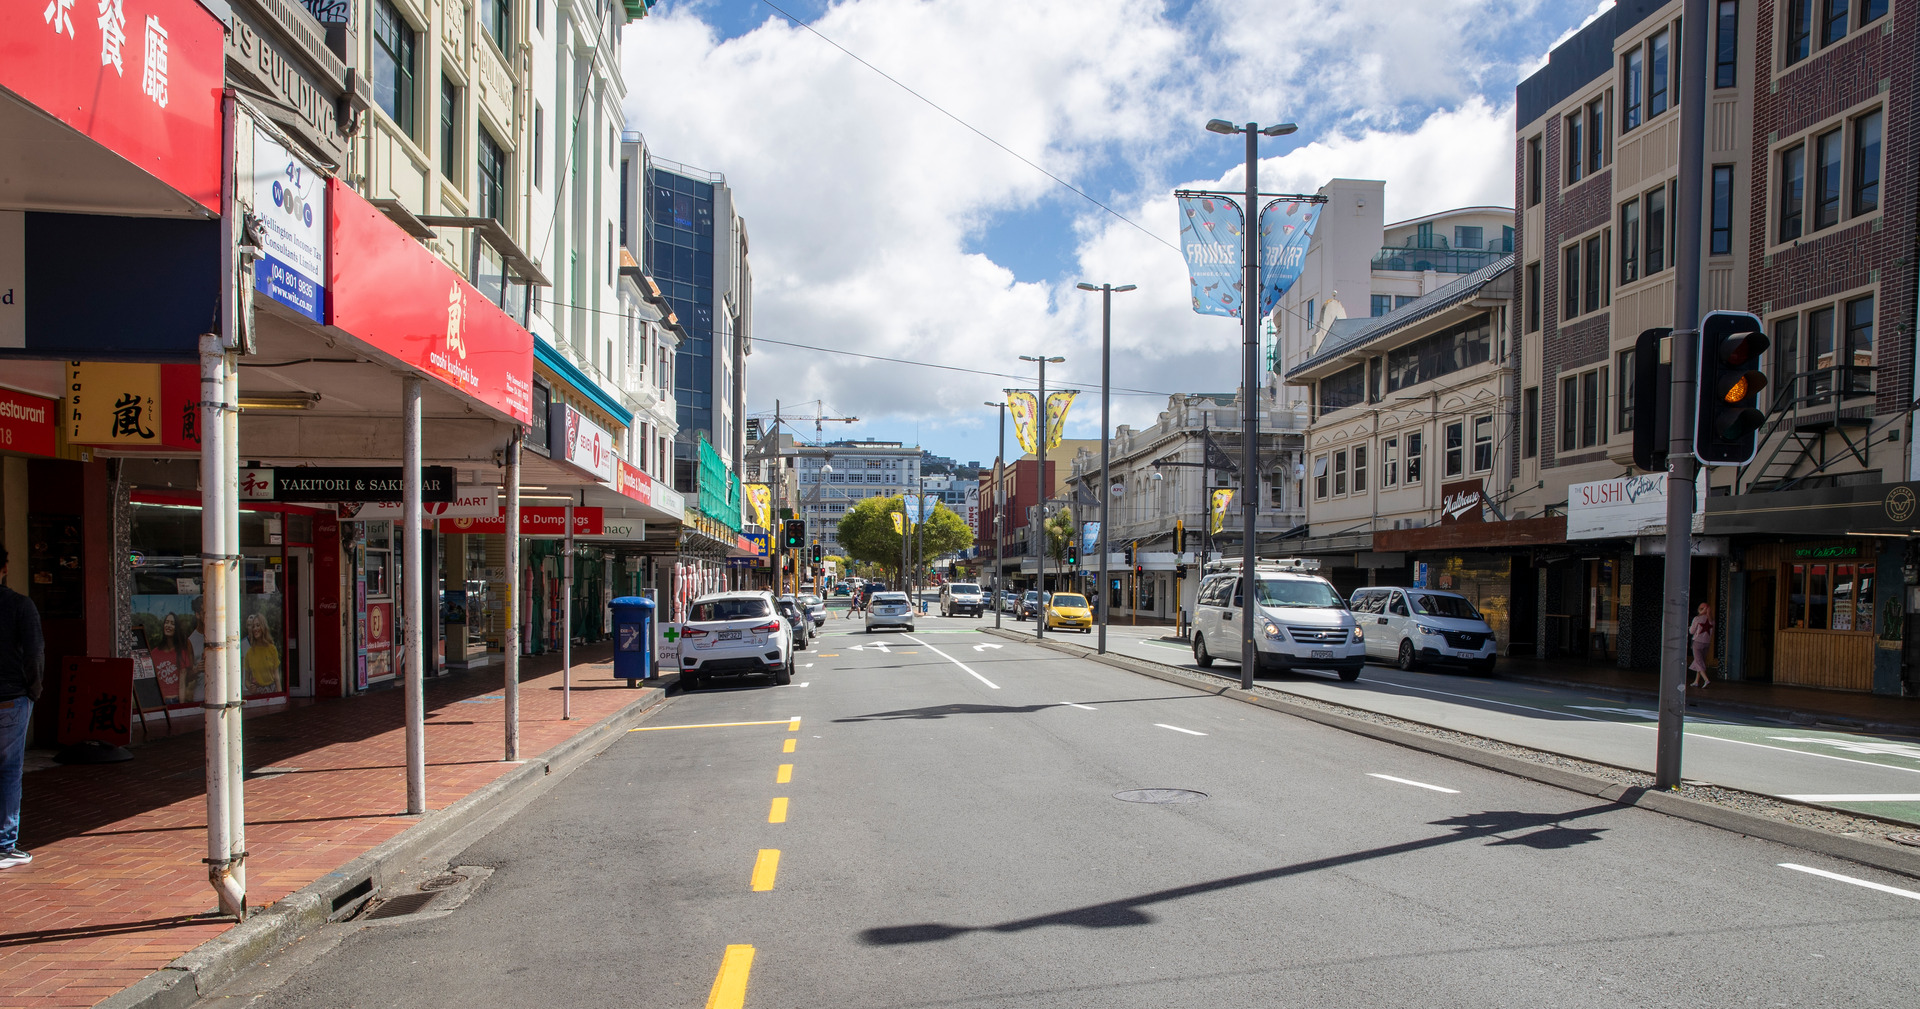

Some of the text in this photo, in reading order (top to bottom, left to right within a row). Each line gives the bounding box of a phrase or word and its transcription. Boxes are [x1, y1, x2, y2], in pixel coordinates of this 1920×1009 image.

[259, 38, 336, 139] BUILDING
[285, 161, 302, 189] 41
[261, 212, 322, 262] Wellington Income Tax
[264, 234, 319, 276] Consultants Limited
[1186, 241, 1236, 267] FRINGE
[271, 264, 313, 298] (04) 801 9835
[0, 288, 15, 305] d
[272, 283, 313, 313] www.witc.co.nz
[446, 280, 467, 360] 嵐
[430, 352, 479, 388] arashi kushiyaki bar
[71, 361, 82, 437] arashi
[0, 401, 45, 424] estaurant
[112, 393, 155, 439] 嵐
[580, 434, 592, 453] SEVEN
[1669, 463, 1675, 473] 2
[241, 472, 269, 496] 和
[280, 479, 350, 491] YAKITORI
[354, 479, 366, 491] &
[421, 480, 441, 491] AR
[1582, 481, 1623, 505] SUSHI
[452, 497, 488, 507] MART
[476, 514, 589, 527] Nood & Dumpngs
[753, 537, 766, 549] 24
[130, 555, 144, 565] PEN
[372, 615, 380, 632] FJ
